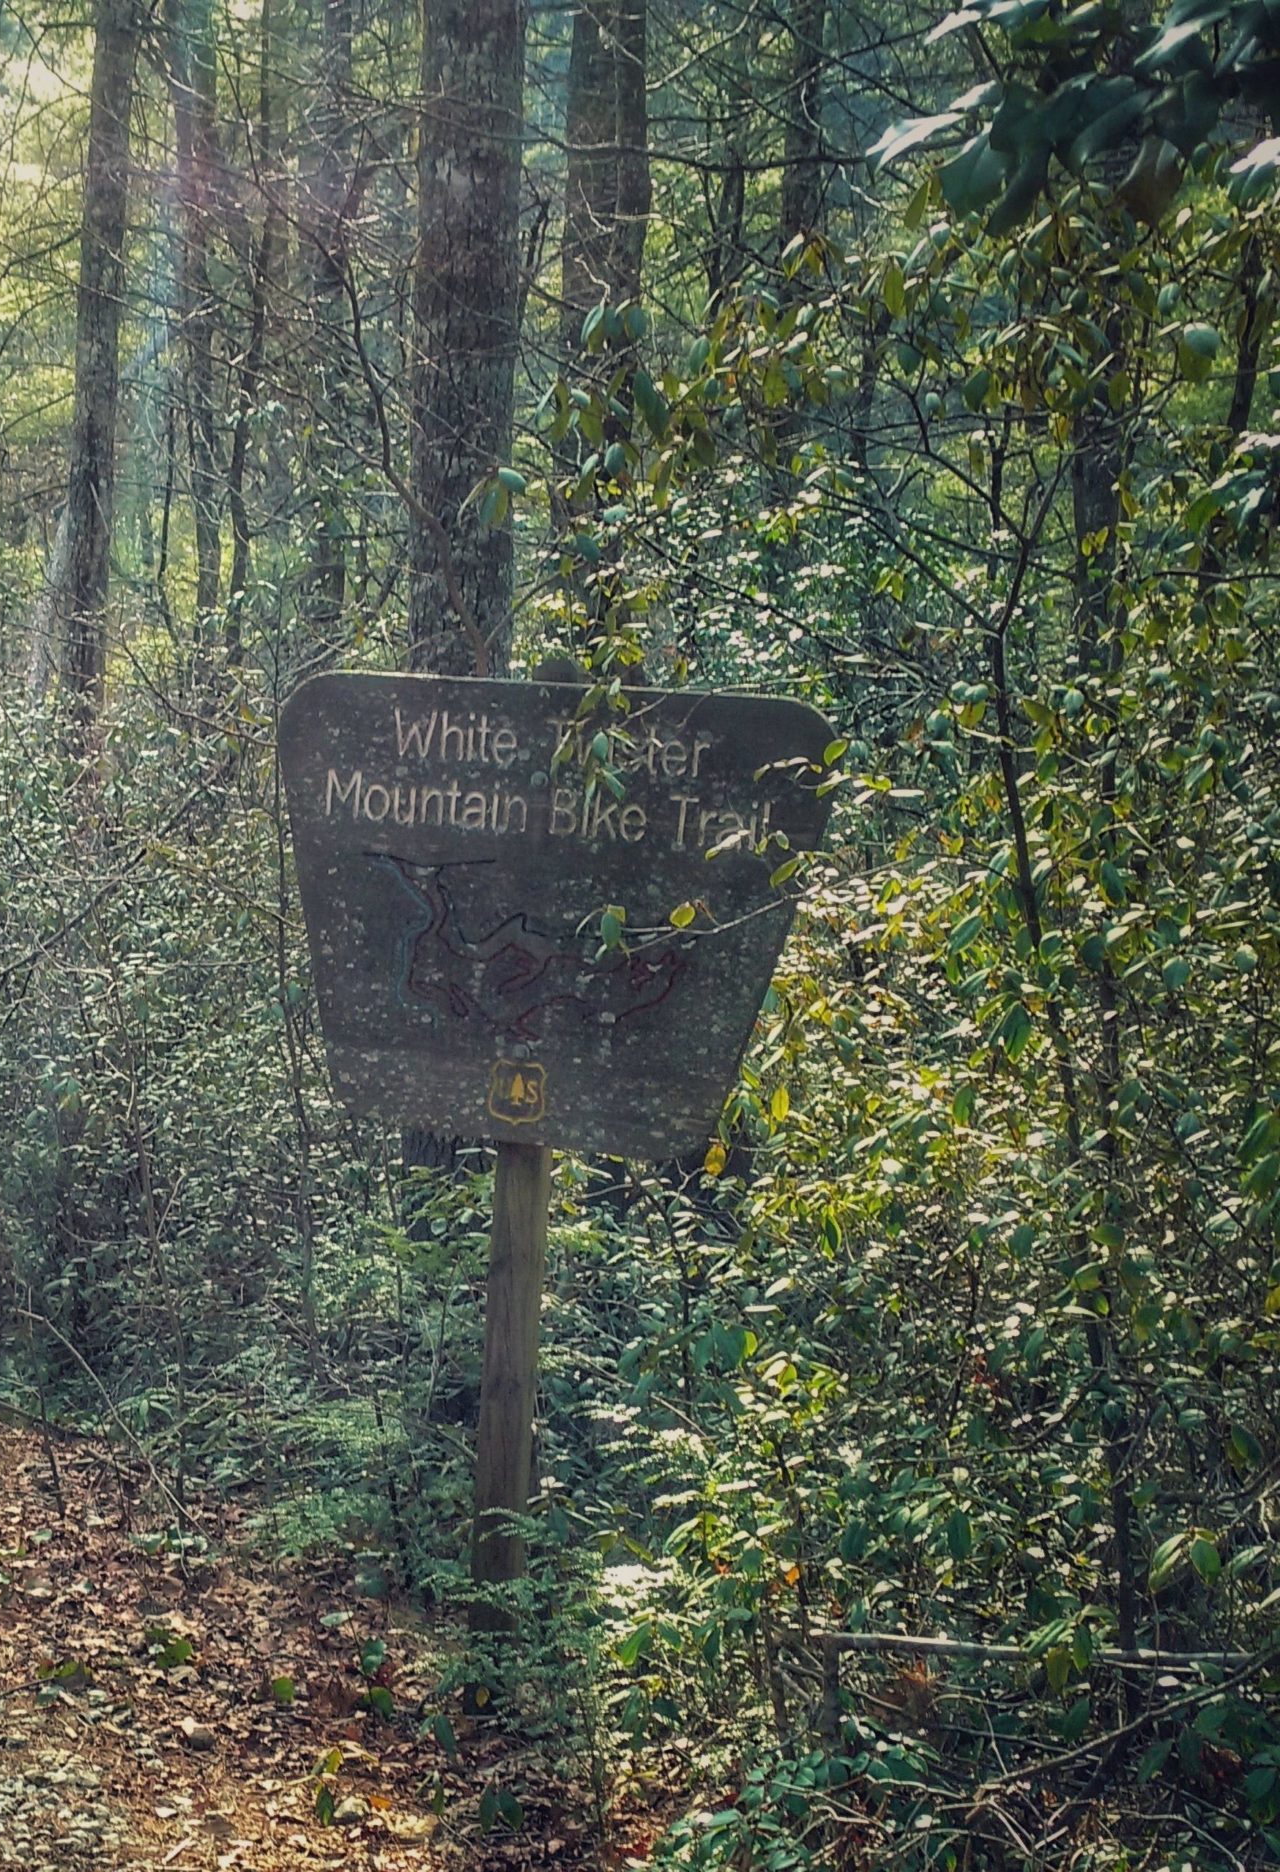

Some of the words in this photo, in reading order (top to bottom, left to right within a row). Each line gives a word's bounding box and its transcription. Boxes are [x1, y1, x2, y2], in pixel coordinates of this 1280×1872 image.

[393, 706, 518, 767] White
[325, 768, 528, 833] Mountain
[549, 787, 647, 842] Bike
[670, 794, 770, 853] Trail
